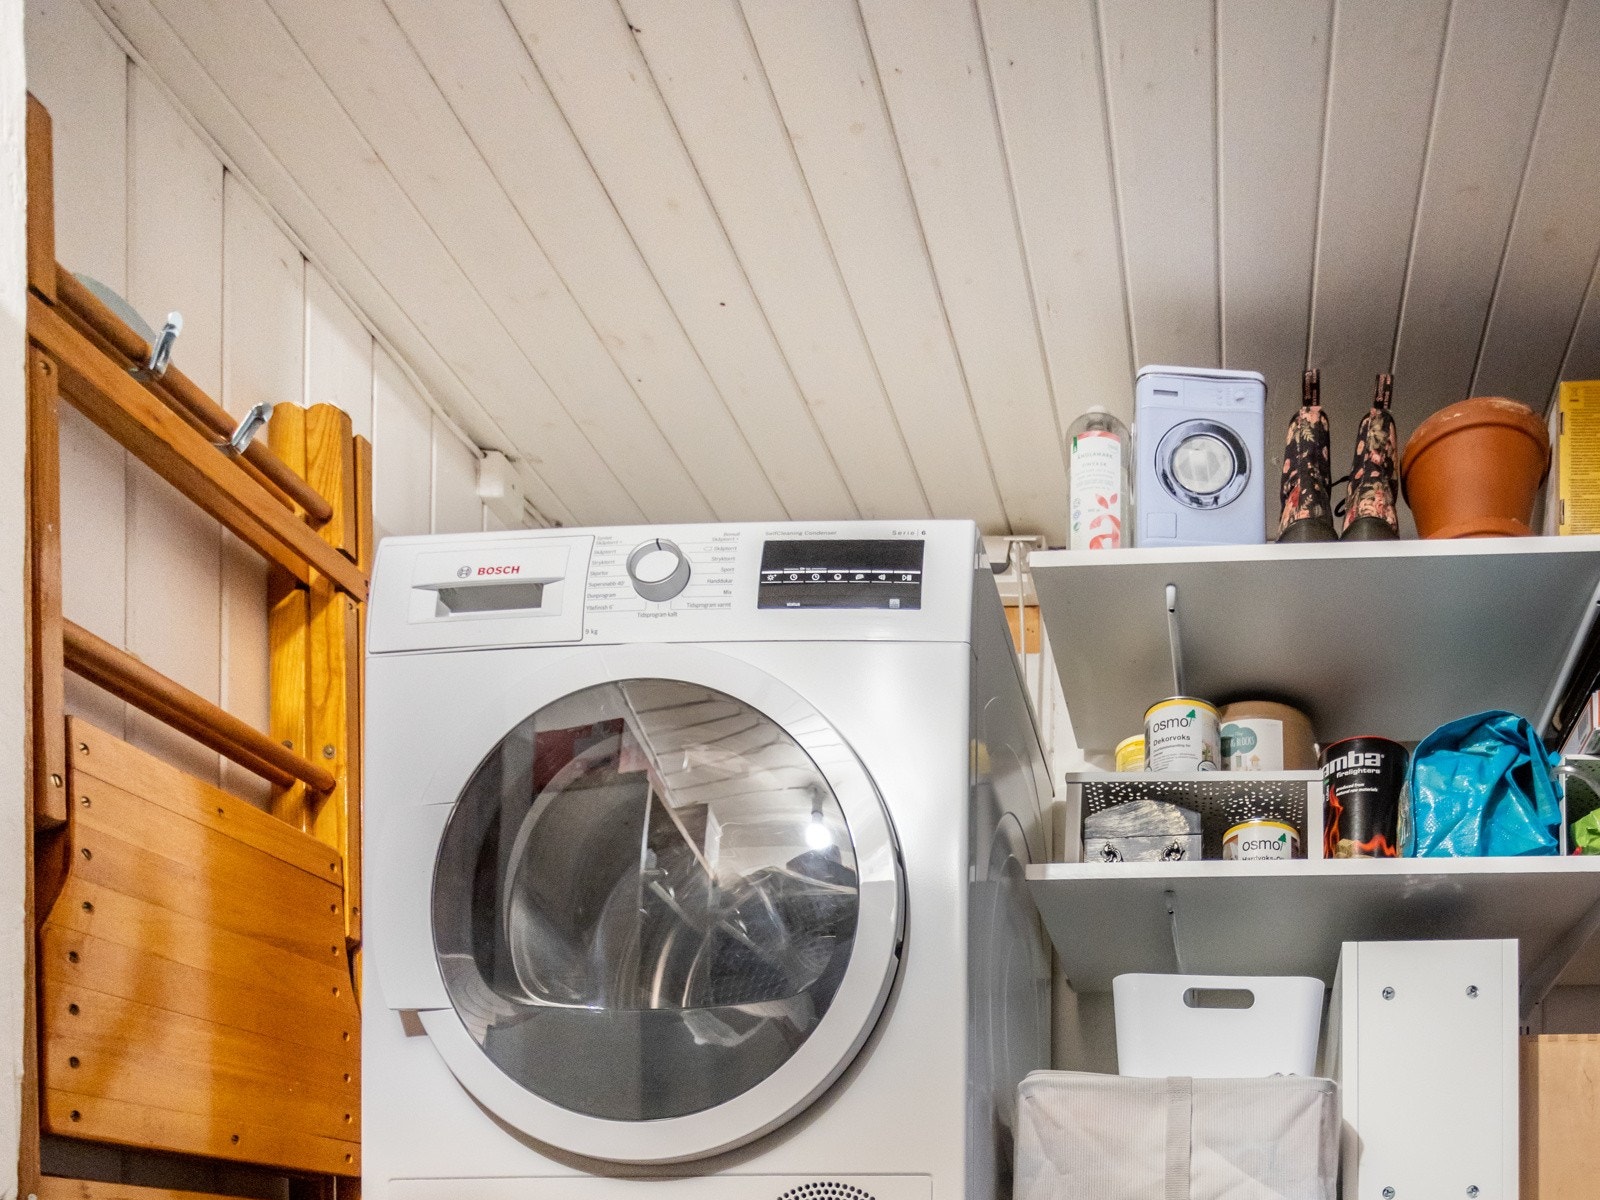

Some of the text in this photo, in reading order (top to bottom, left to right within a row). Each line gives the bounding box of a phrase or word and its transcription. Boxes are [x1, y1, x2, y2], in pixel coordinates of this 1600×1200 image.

[477, 565, 520, 576] BOSCH
[591, 628, 598, 636] kg
[1152, 717, 1189, 734] osmo
[1153, 734, 1191, 747] Dekorvoks
[1336, 768, 1381, 779] firelighters
[1242, 839, 1280, 852] osmo
